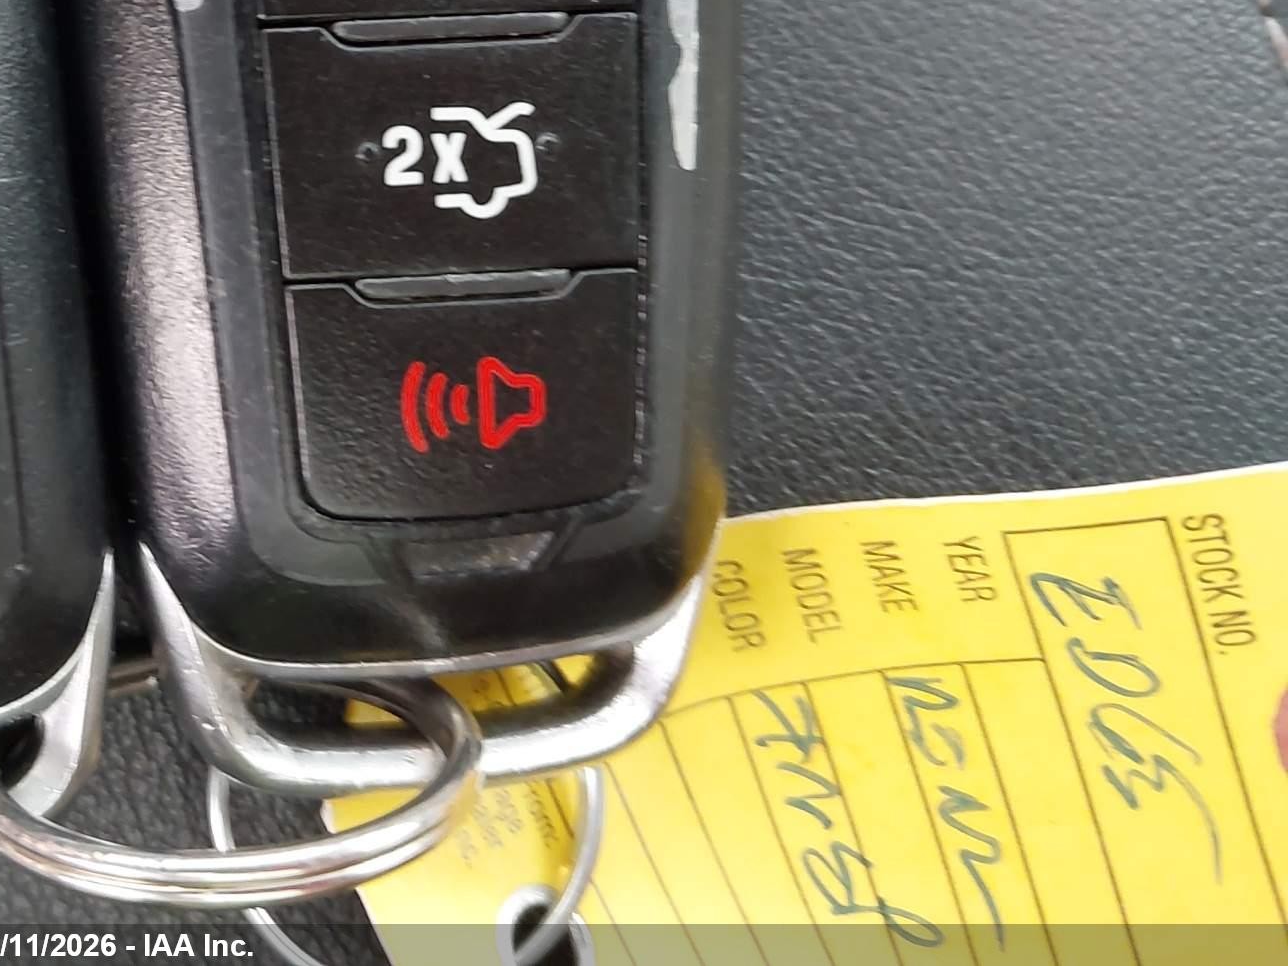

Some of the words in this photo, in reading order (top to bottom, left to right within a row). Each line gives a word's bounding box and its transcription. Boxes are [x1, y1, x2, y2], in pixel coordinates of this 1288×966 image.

[781, 548, 843, 644] MODEL
[859, 540, 919, 613] MAKE
[943, 536, 997, 603] YEAR
[1181, 513, 1243, 602] STOCK
[712, 560, 766, 652] COLOR
[1208, 608, 1257, 656] NO.
